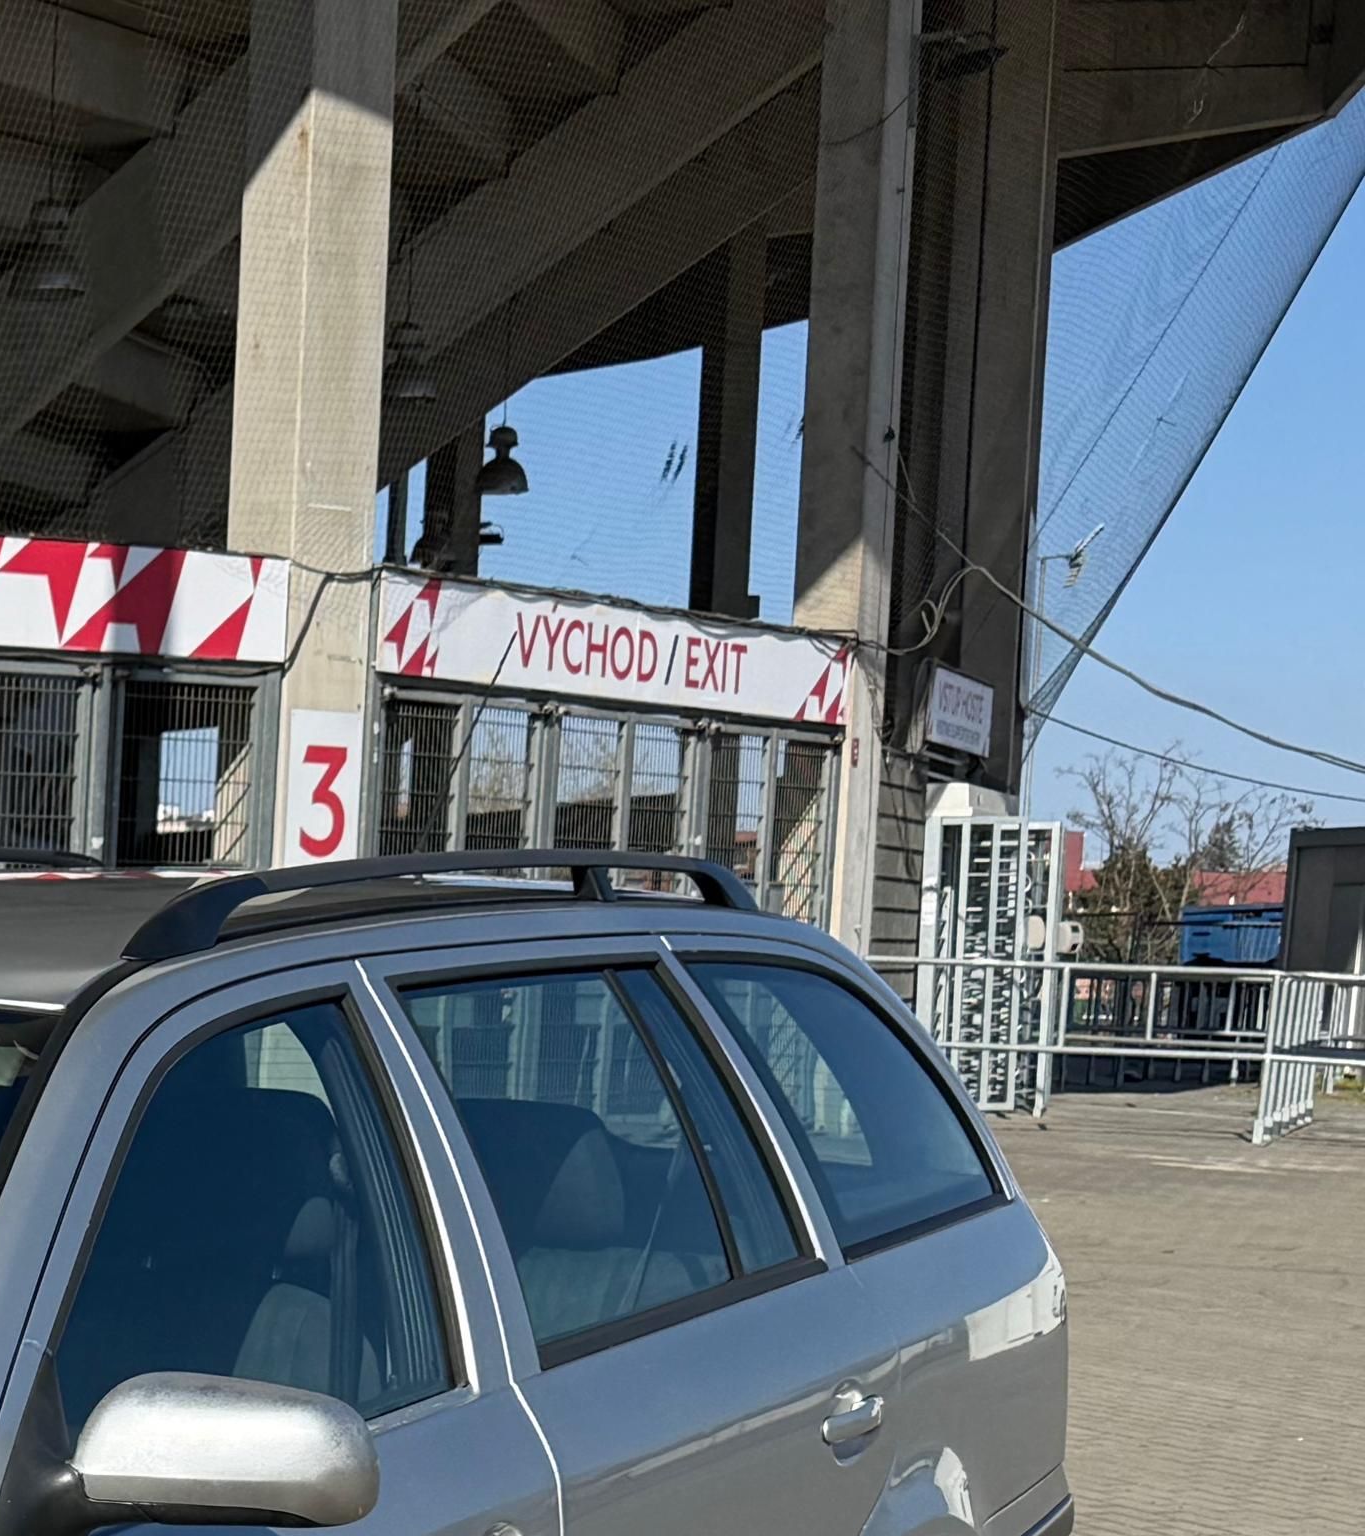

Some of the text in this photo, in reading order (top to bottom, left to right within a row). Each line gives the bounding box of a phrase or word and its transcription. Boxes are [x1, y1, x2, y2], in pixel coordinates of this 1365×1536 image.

[516, 603, 748, 694] VÝCHOD / EXIT
[299, 745, 348, 858] 3
